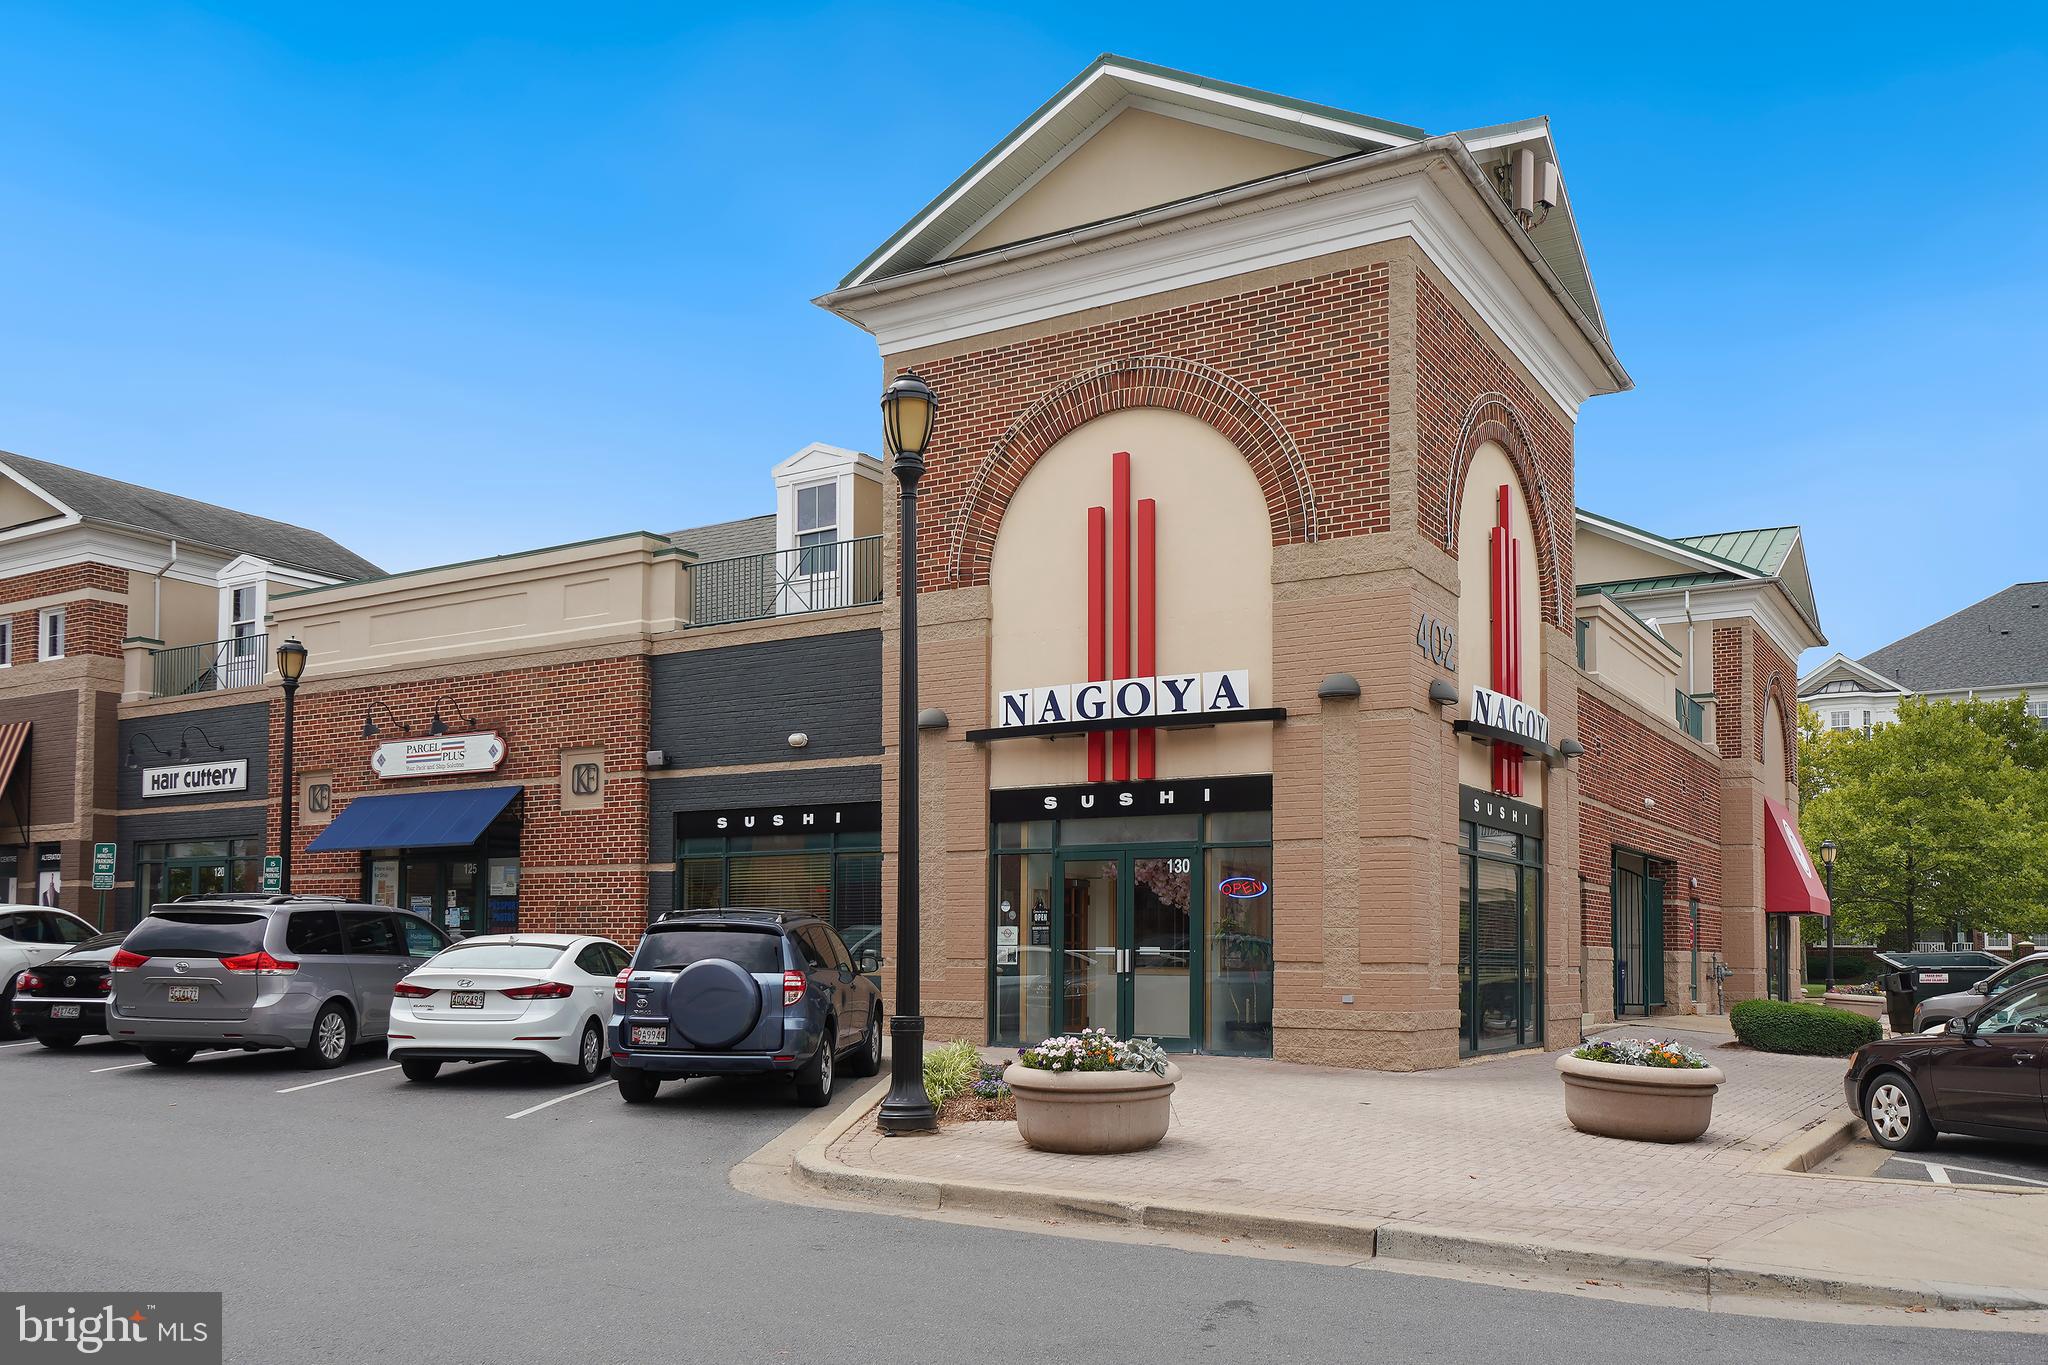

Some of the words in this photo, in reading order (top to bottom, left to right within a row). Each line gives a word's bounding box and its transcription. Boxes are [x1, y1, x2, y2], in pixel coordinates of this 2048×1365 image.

[1417, 613, 1456, 671] 402
[1002, 674, 1245, 727] NAGOYA
[406, 743, 440, 754] PARCEL
[442, 751, 465, 761] PLUS
[152, 772, 179, 790] Hair
[184, 768, 237, 787] cuttery
[1044, 788, 1210, 810] SUSHI
[1474, 799, 1528, 826] SUSHI
[717, 812, 841, 829] SUSHI
[214, 867, 225, 877] 120
[464, 863, 478, 874] 125
[1167, 858, 1190, 873] 130
[1221, 881, 1263, 896] OPEN
[1034, 913, 1048, 921] OPEN
